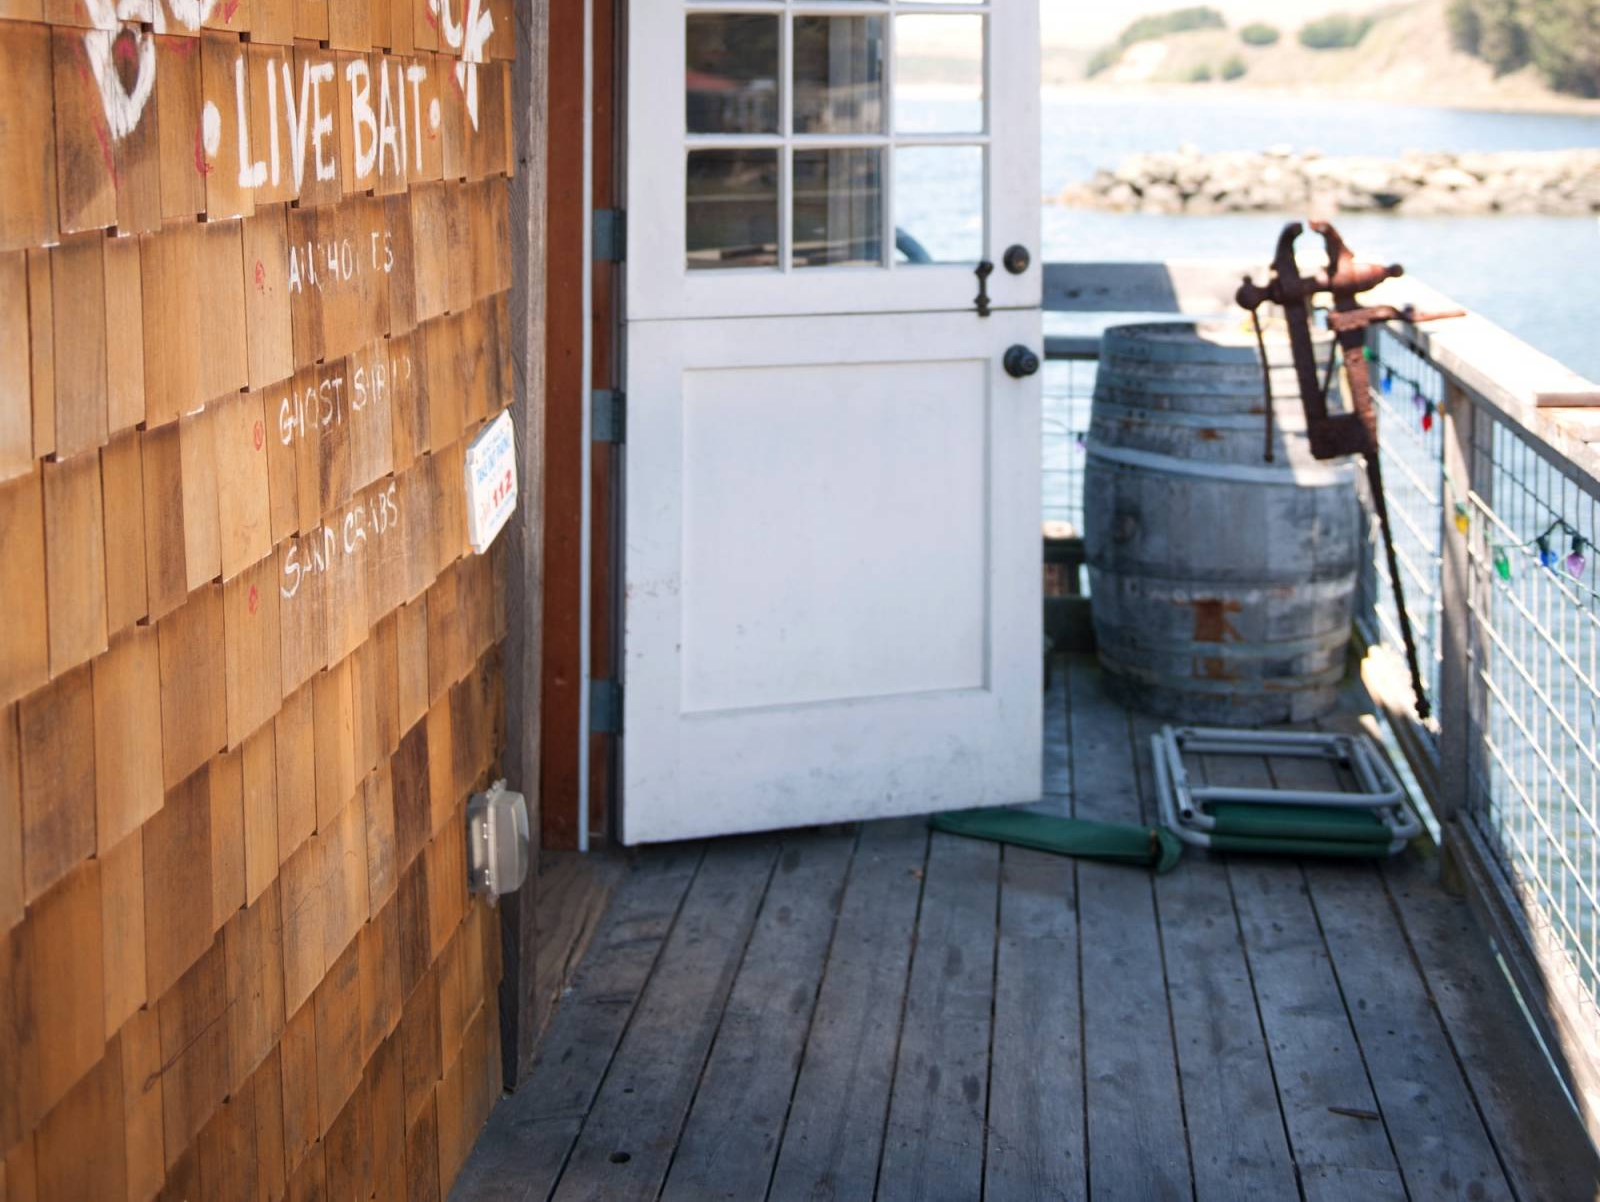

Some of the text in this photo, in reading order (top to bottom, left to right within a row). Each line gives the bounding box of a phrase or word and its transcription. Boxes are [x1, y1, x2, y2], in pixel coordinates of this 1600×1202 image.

[234, 54, 428, 192] LIVE BAIT
[279, 377, 343, 446] GHOST
[280, 525, 337, 598] SAND
